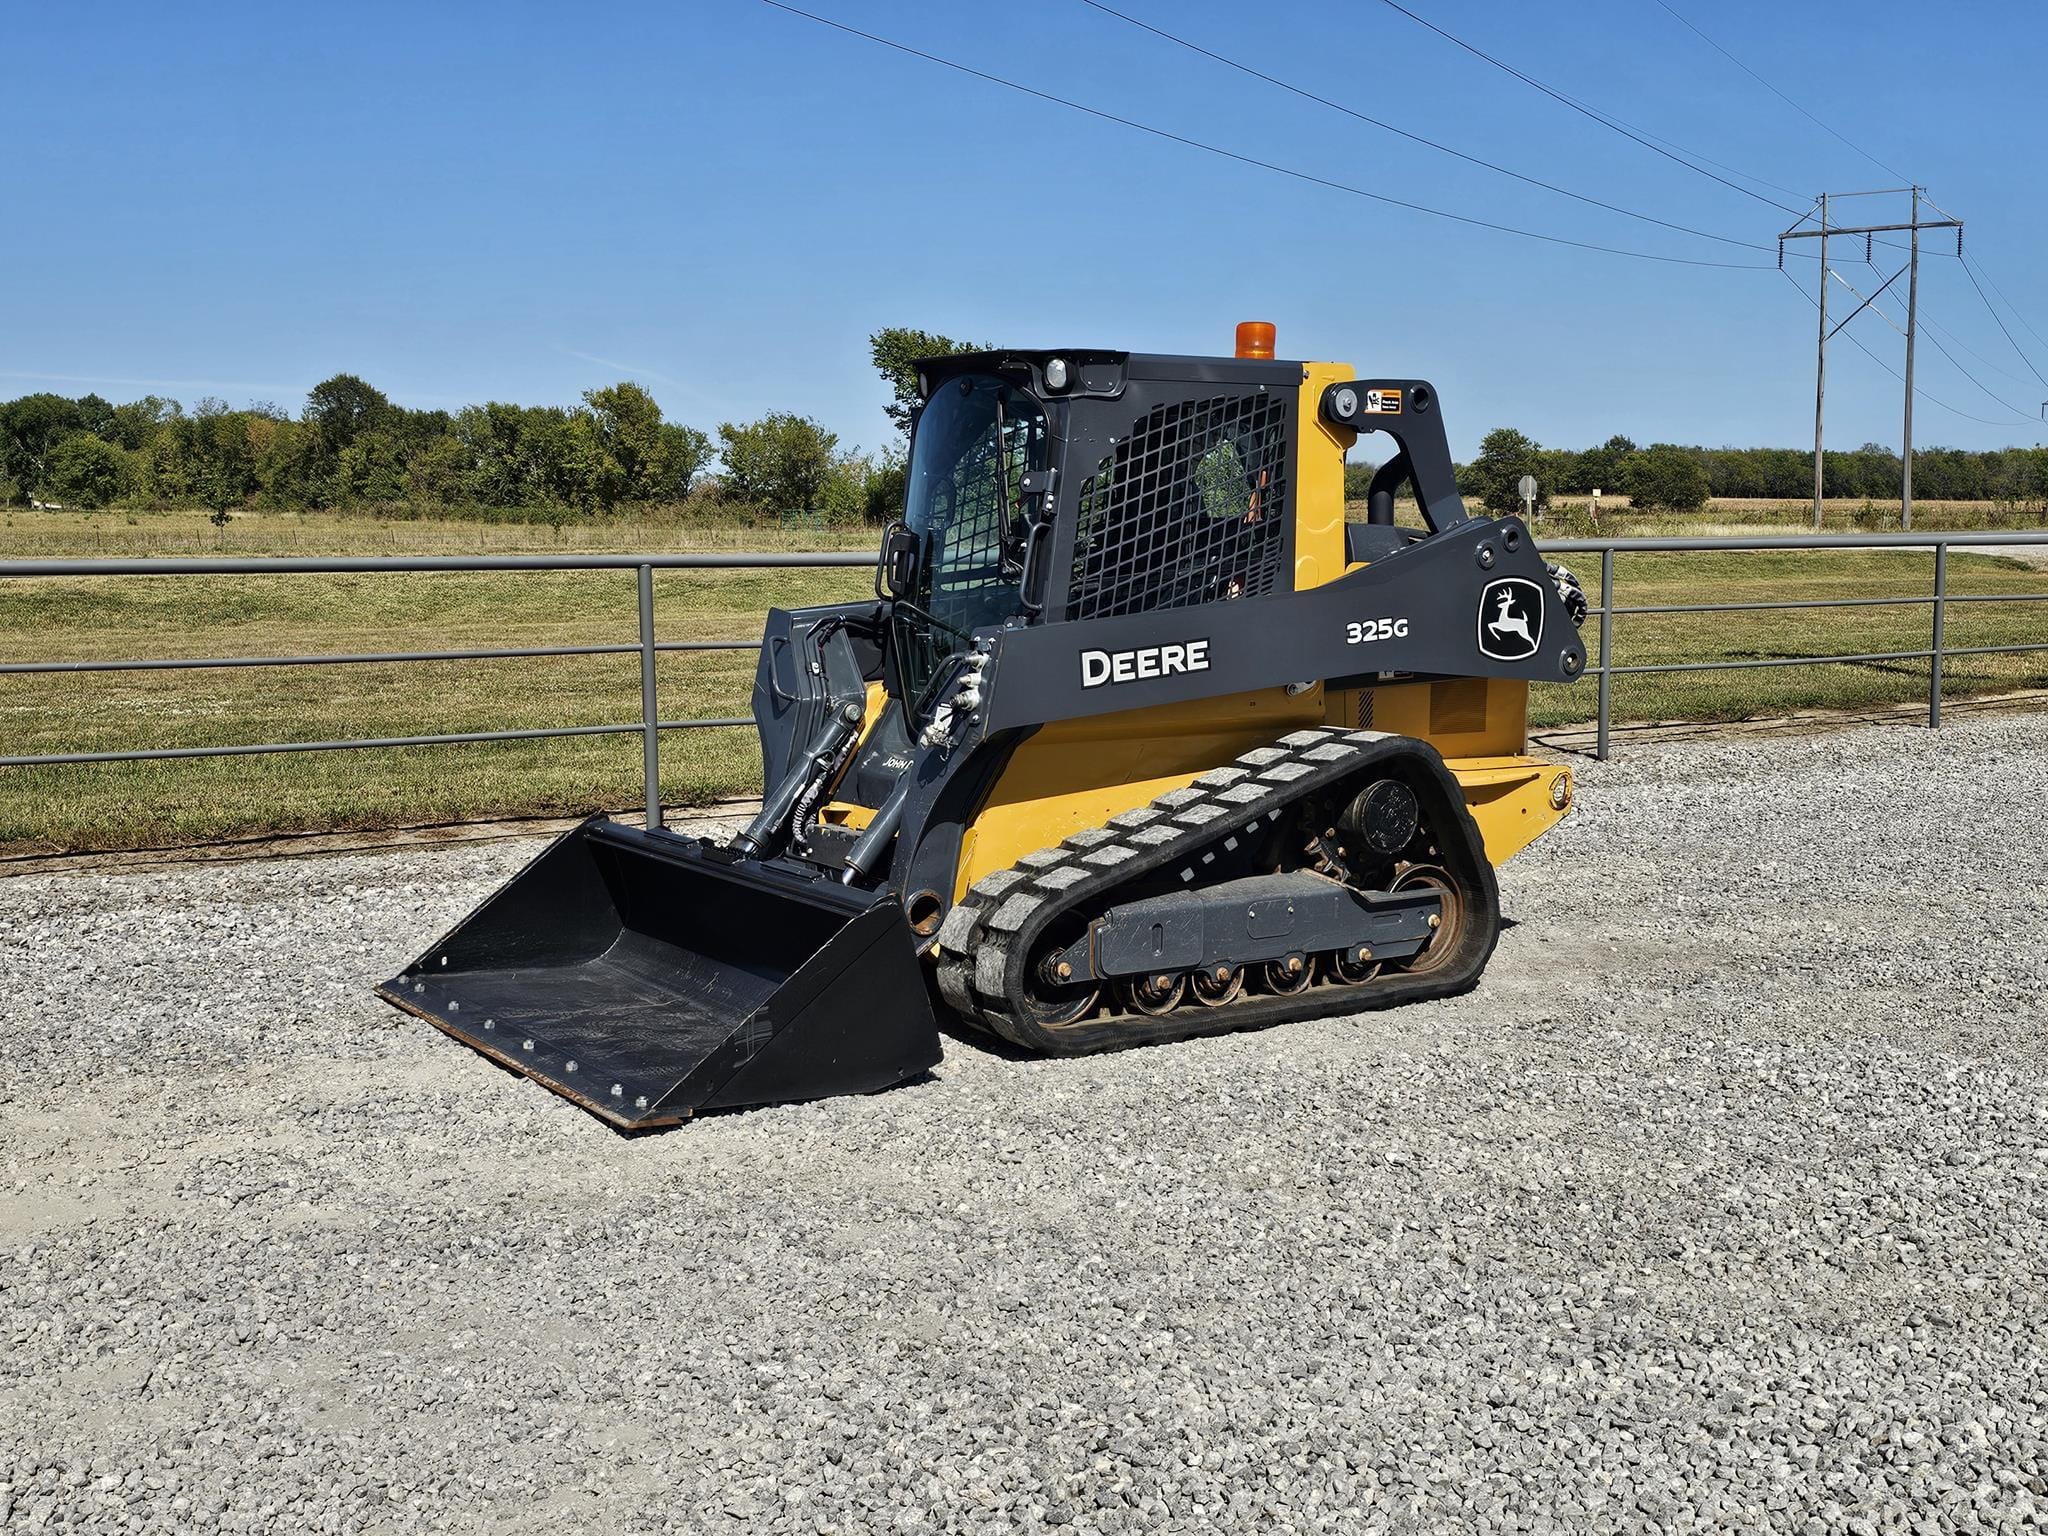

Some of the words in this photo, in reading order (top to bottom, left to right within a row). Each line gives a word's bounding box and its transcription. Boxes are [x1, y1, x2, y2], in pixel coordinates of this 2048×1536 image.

[1346, 618, 1408, 644] 325G
[1081, 640, 1209, 687] DEERE
[882, 756, 908, 769] JOHN
